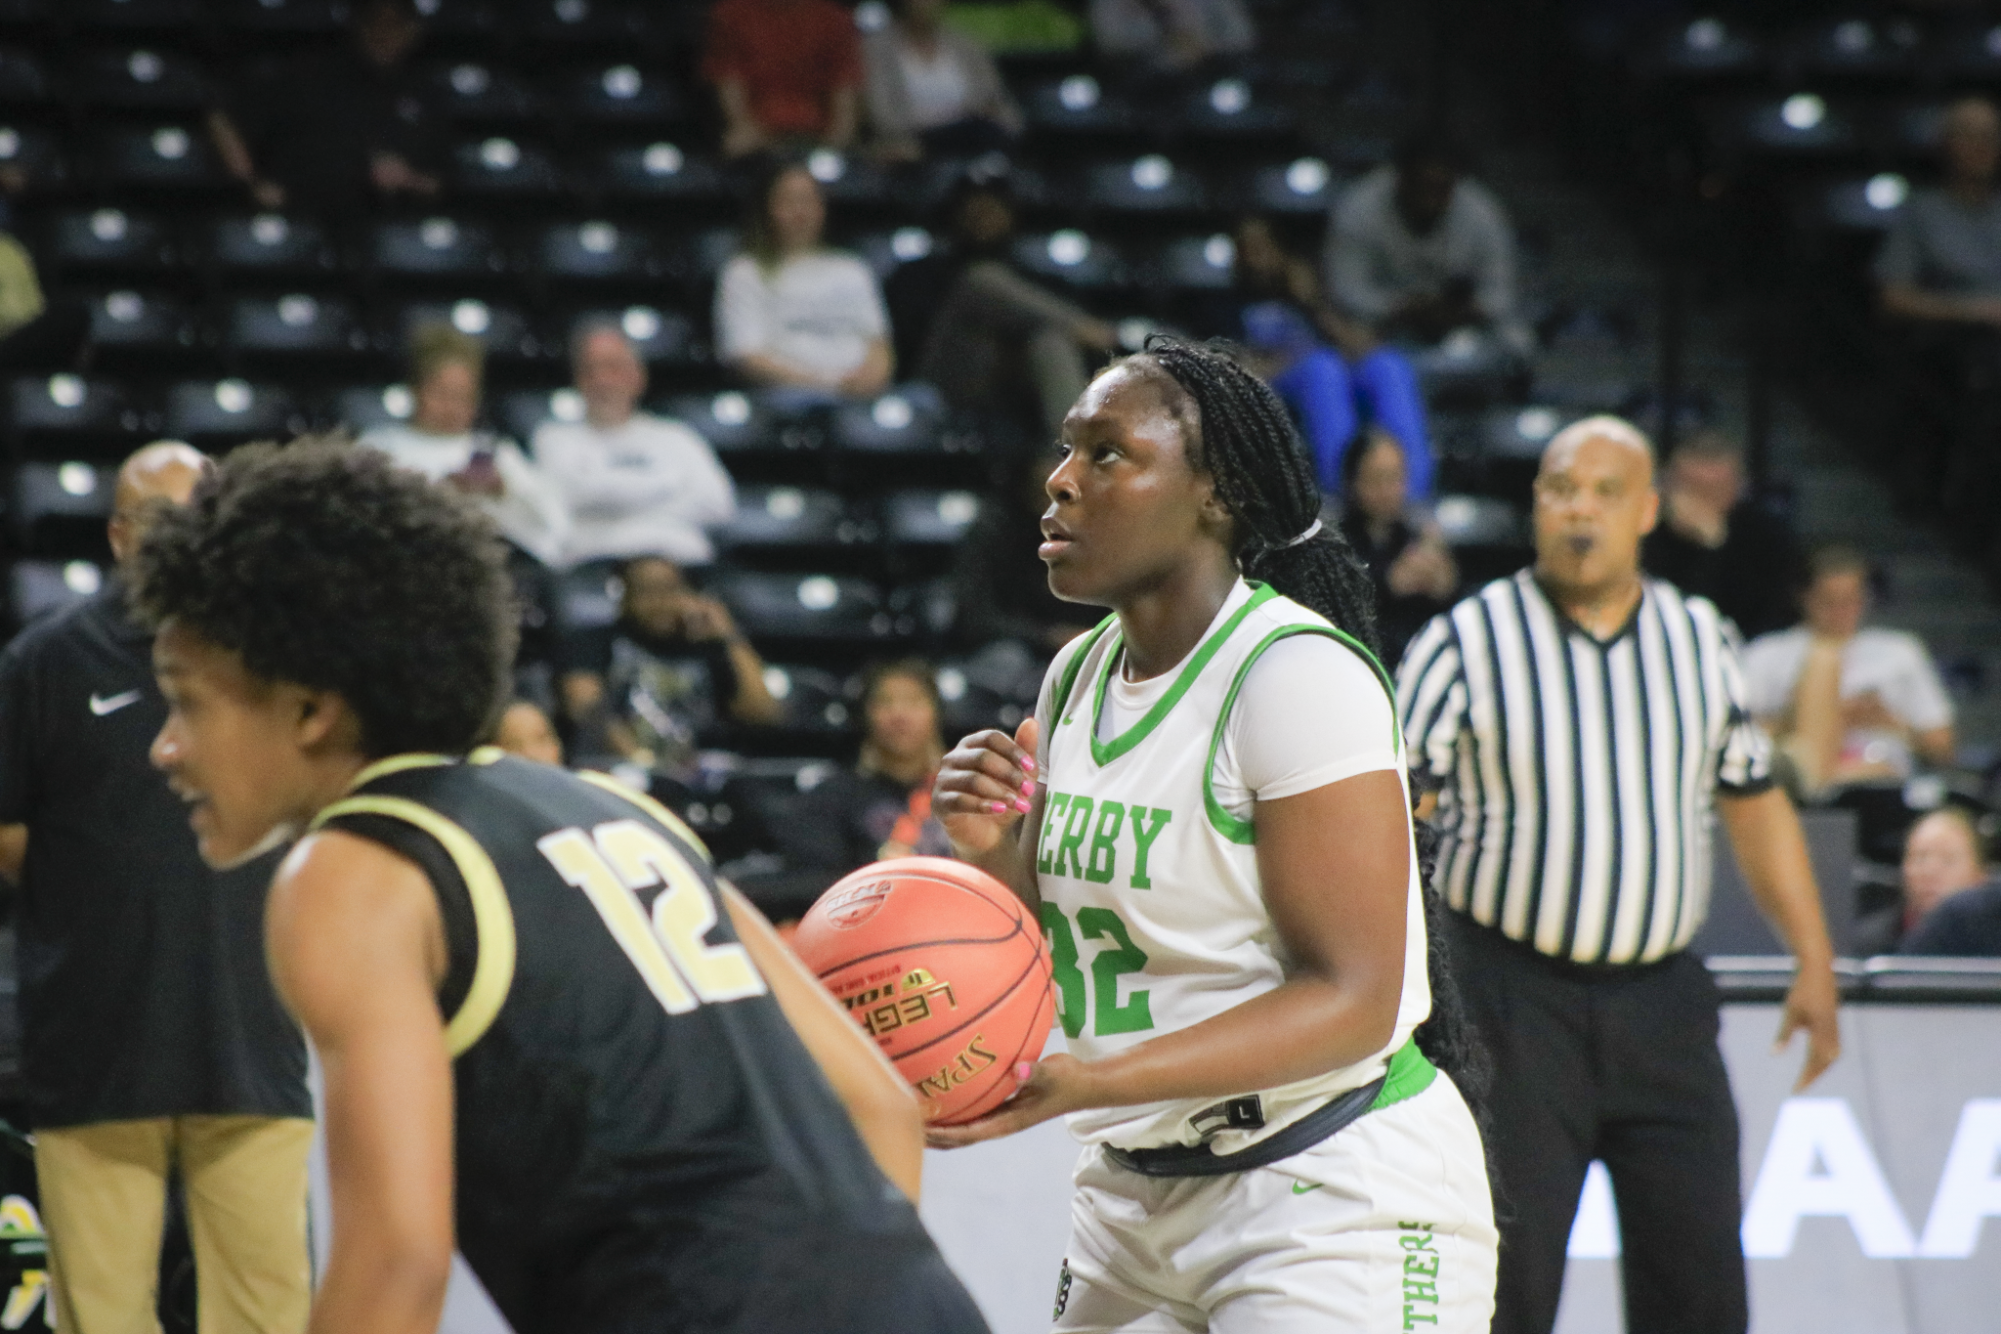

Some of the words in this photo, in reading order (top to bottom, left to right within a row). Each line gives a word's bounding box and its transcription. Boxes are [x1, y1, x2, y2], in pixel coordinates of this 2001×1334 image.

[1038, 790, 1173, 890] ERBY
[536, 819, 767, 1015] 12
[1041, 900, 1155, 1040] 32
